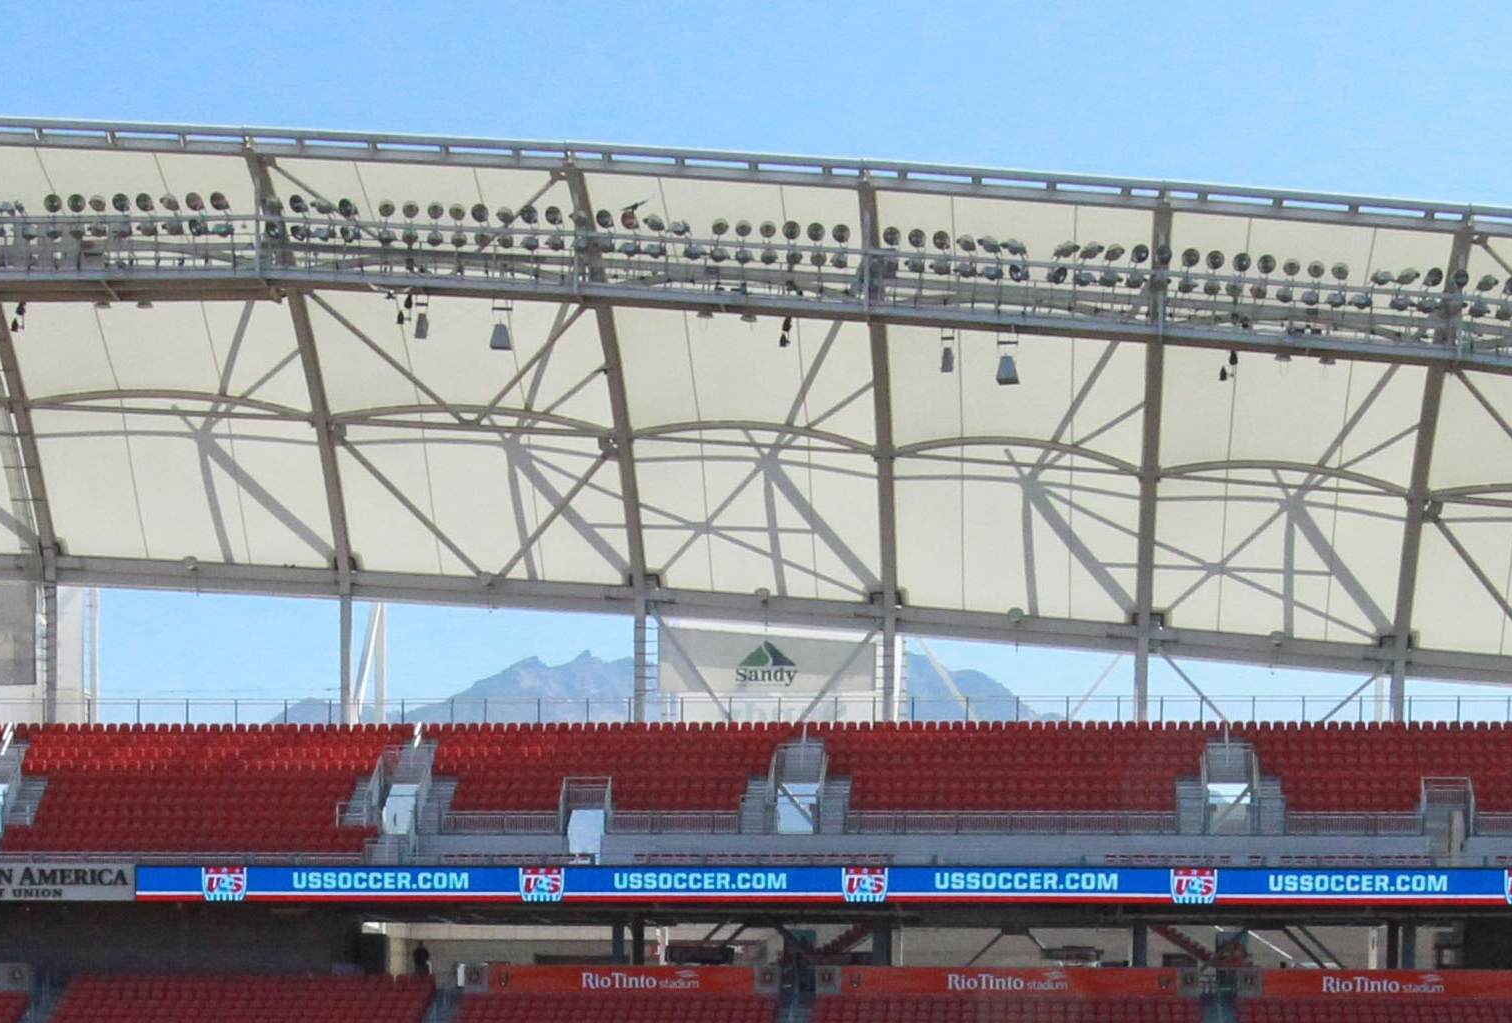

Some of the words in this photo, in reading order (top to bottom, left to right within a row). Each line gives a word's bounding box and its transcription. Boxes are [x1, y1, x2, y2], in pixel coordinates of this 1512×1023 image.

[735, 667, 798, 687] Sandy
[19, 866, 129, 886] AMERICA
[293, 871, 470, 890] USSOCCER.COM
[614, 872, 788, 890] USSOCCER.COM
[935, 872, 1119, 891] USSOCCER.COM
[1269, 874, 1449, 893] USSOCCER.COM
[12, 887, 63, 899] UNION
